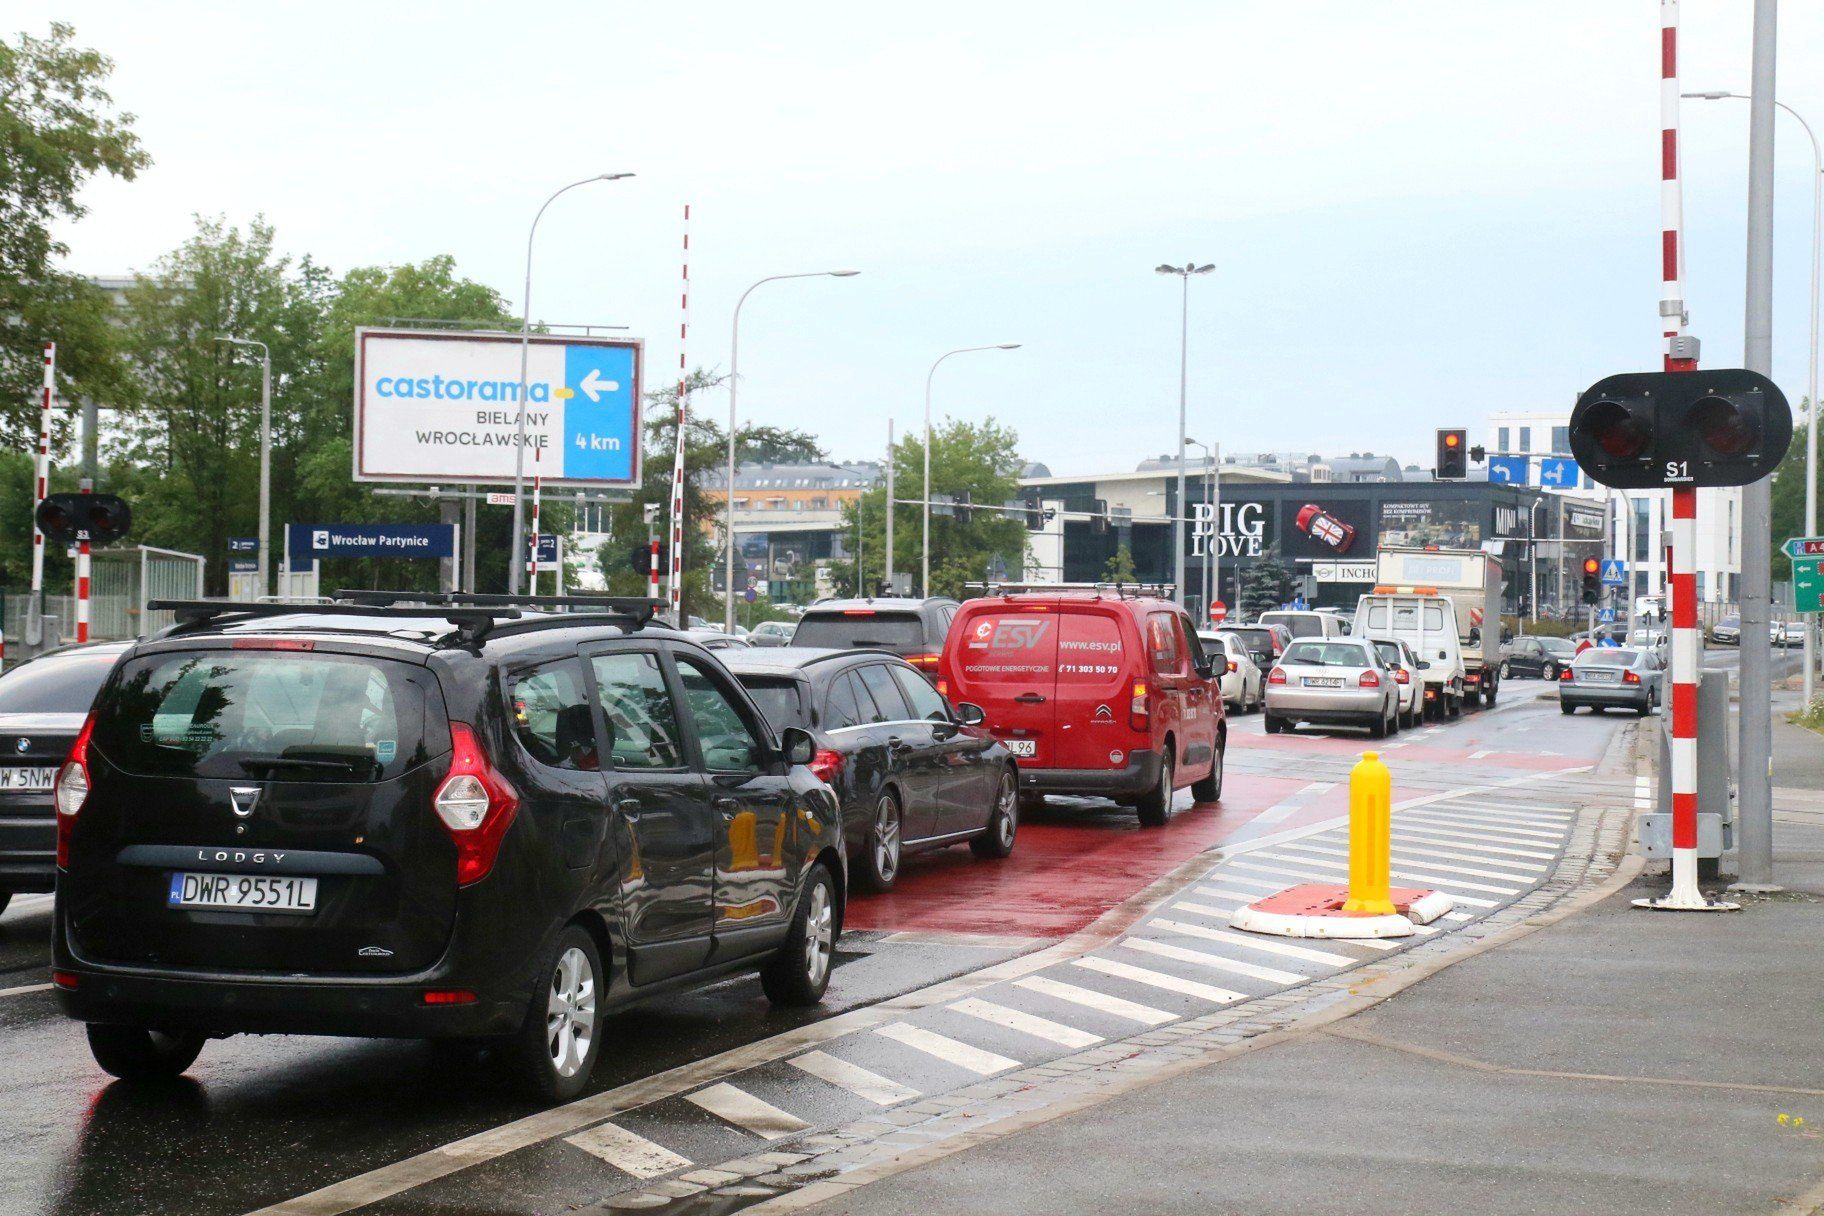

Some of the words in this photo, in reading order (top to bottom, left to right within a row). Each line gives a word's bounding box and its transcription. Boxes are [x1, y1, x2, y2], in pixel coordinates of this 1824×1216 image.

[376, 375, 549, 402] castorama
[476, 411, 549, 426] BIELANY
[416, 430, 549, 448] WROCŁAWSKIE
[576, 433, 586, 449] 4
[591, 433, 620, 450] km
[1666, 461, 1687, 477] S1
[491, 494, 517, 503] ams
[1192, 503, 1265, 536] BIG
[1496, 507, 1516, 535] MINI
[332, 535, 376, 545] Wrocław
[380, 535, 429, 548] Partynice
[1192, 536, 1263, 556] LOVE
[992, 621, 1050, 649] ESV
[1060, 641, 1121, 654] www.esv.pl
[1066, 665, 1076, 673] 71
[1079, 665, 1093, 673] 303
[18, 769, 59, 786] 5NW
[198, 851, 285, 863] LODGY
[182, 875, 229, 903] DWR
[237, 878, 311, 907] 9551L
